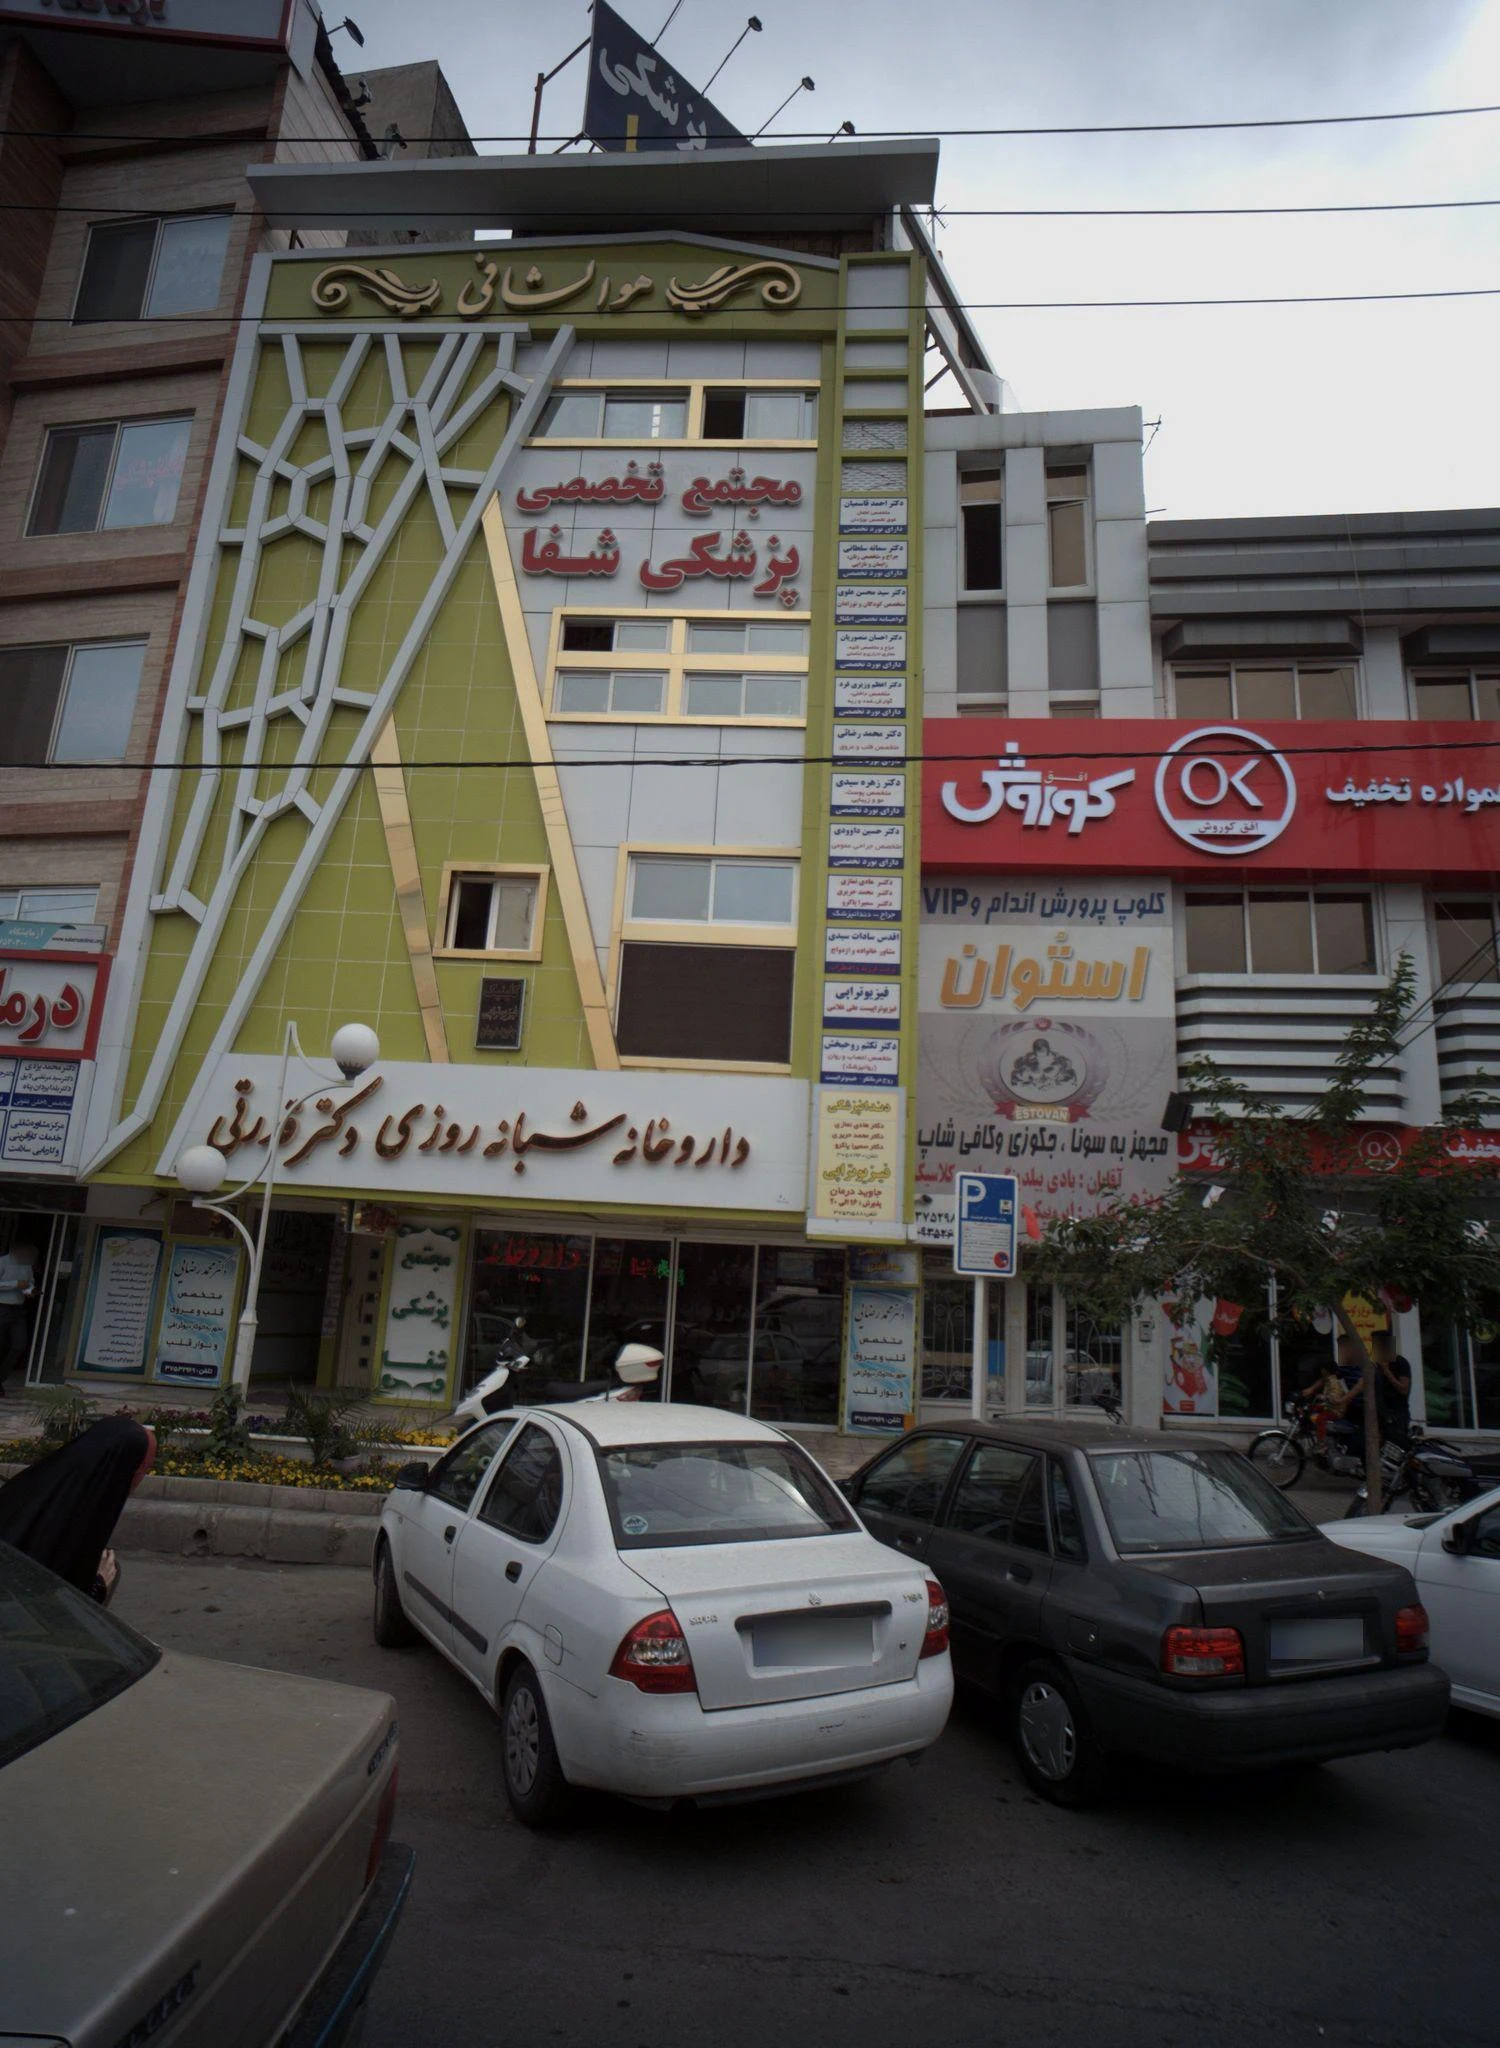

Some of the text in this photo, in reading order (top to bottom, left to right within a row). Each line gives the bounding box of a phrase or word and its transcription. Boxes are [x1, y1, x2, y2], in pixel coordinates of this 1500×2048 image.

[515, 460, 803, 520] مجتمع تخصصی
[889, 500, 904, 508] دکتر
[885, 526, 903, 534] دارای
[843, 544, 868, 553] سلطانی
[889, 545, 904, 553] دکتر
[521, 524, 801, 607] پزشکی شفا
[885, 570, 903, 578] دارای
[891, 589, 906, 597] دکتر
[889, 634, 902, 642] دکتر
[882, 661, 902, 669] دارای
[888, 681, 902, 689] دکتر
[881, 708, 902, 717] دارای
[885, 730, 902, 739] دکتر
[861, 780, 881, 789] زهره
[883, 779, 901, 789] دکتر
[941, 742, 1500, 835] کوروش OK تخفیف مواره
[835, 807, 900, 816] دارای بورد تخصصی
[885, 828, 900, 837] دکتر
[1197, 820, 1259, 835] افق کوروش
[833, 858, 900, 868] دارای بورد تخصصی
[923, 887, 969, 914] VIP
[985, 892, 1036, 925] اندام
[1040, 887, 1108, 926] پرورش
[1113, 892, 1165, 926] کلوپ
[835, 985, 889, 1001] فیزیوتراپی
[880, 1042, 897, 1052] دکتر
[827, 1099, 892, 1115] دندانپزشکی
[1015, 1108, 1069, 1121] ESTOVAN
[282, 1075, 384, 1168] دکتر
[375, 1103, 479, 1161] روزی
[483, 1101, 627, 1175] شبانه
[613, 1117, 750, 1168] داروخانه
[917, 1117, 957, 1159] شاپ
[1008, 1125, 1057, 1159] جکوزی
[1070, 1127, 1105, 1157] سونا
[1109, 1133, 1126, 1161] به
[1128, 1131, 1169, 1163] مجهز
[822, 1162, 891, 1184] فیزیوتراپی
[962, 1178, 986, 1219] P
[177, 1290, 222, 1300] متخصص
[170, 1305, 194, 1316] عروق
[203, 1307, 224, 1317] قلب
[391, 1291, 449, 1330] پزشکی
[859, 1336, 903, 1346] متخصص
[886, 1352, 906, 1362] قلب
